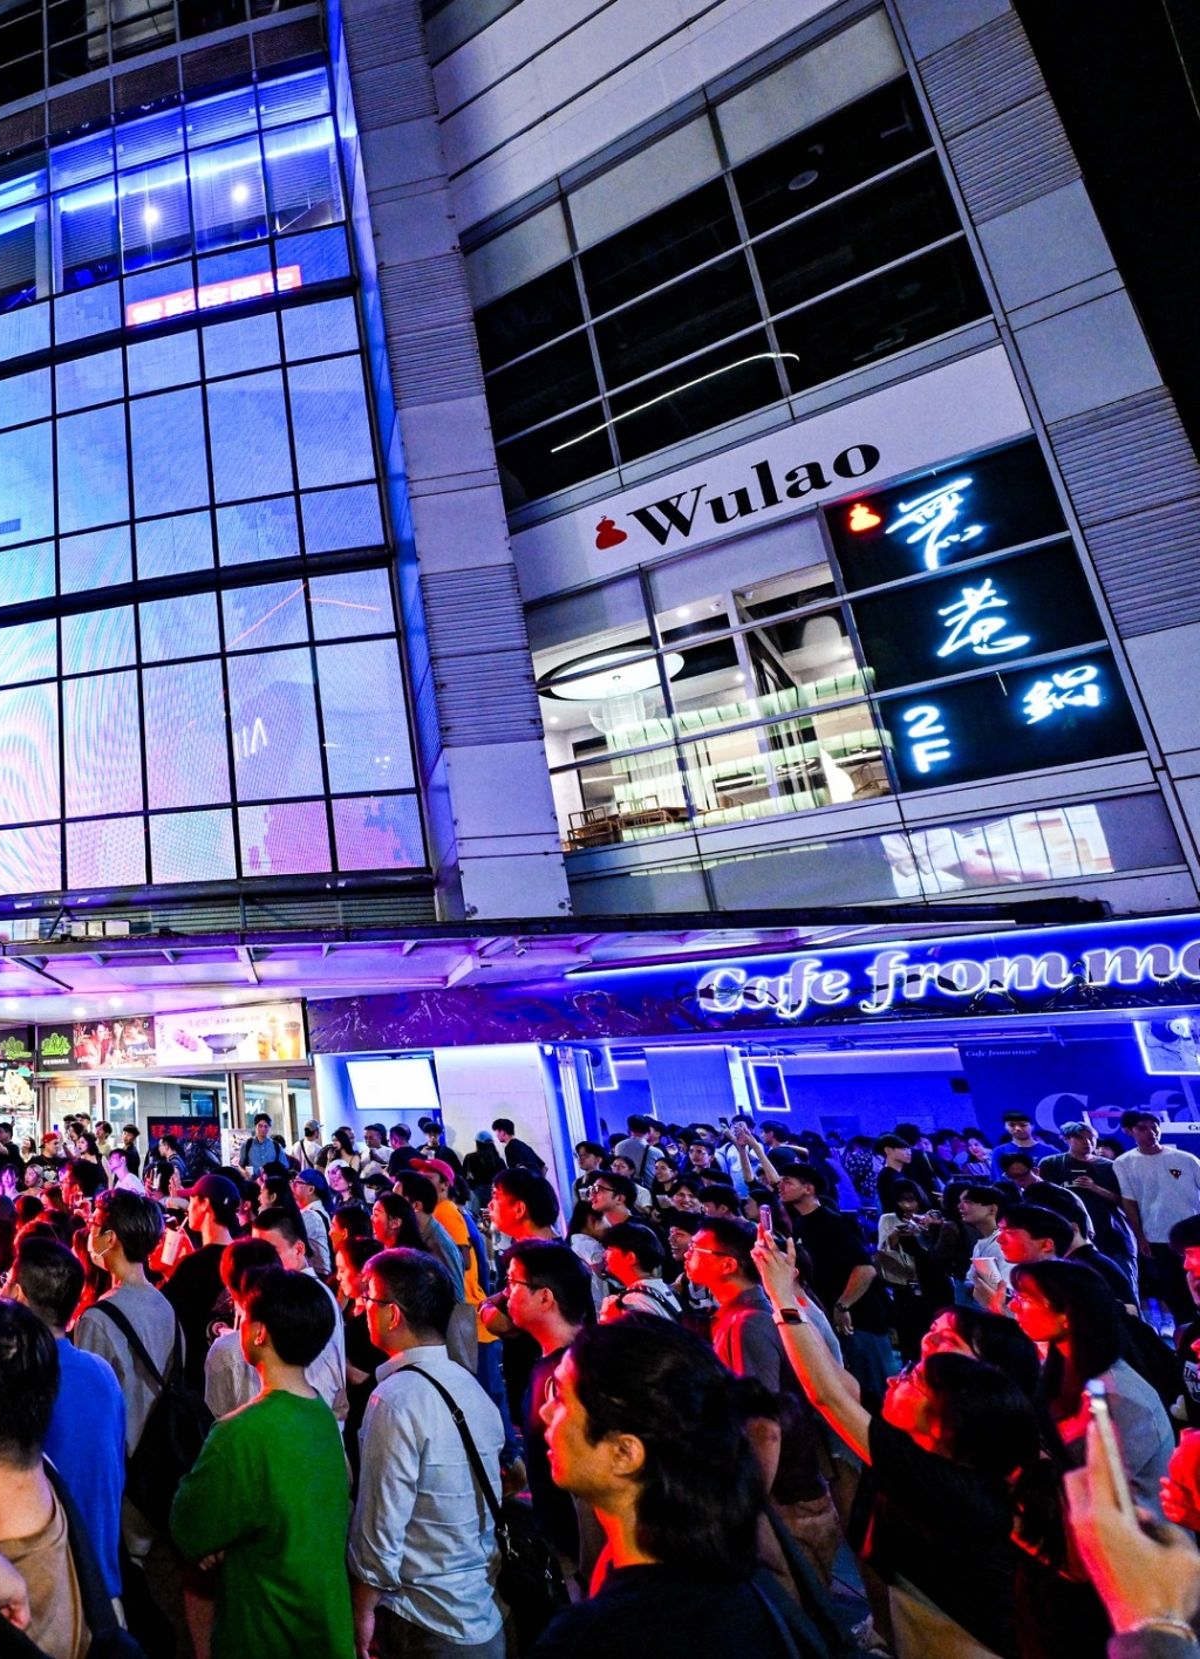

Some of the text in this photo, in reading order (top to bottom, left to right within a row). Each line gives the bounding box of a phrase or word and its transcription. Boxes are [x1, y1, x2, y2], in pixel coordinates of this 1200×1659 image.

[627, 443, 880, 546] Wulao
[903, 705, 951, 773] 2F
[698, 957, 851, 1019] Cafe
[860, 951, 1077, 1014] from
